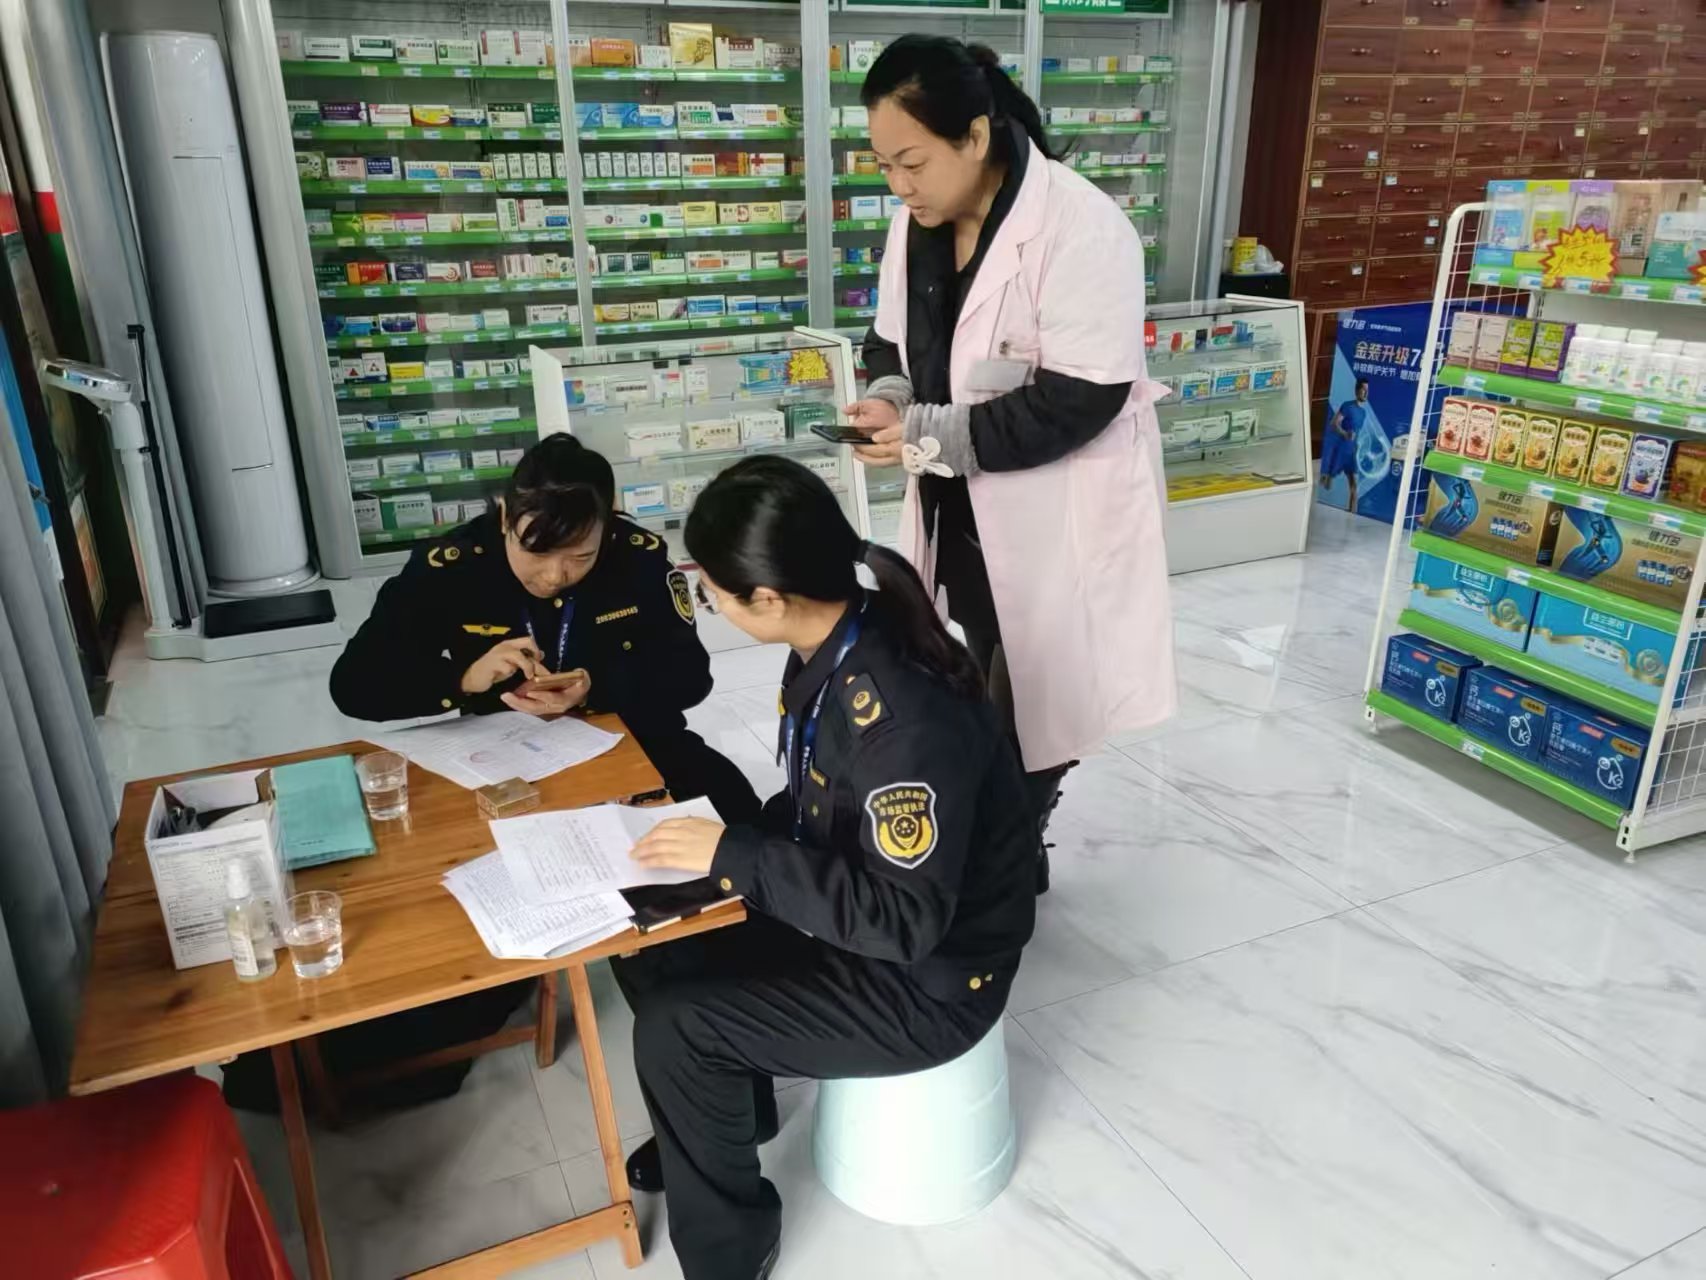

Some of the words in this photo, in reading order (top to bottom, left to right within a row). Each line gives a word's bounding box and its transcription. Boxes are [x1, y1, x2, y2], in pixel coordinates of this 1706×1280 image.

[1353, 341, 1424, 367] 金装升级7
[873, 790, 928, 809] 中华人民共和国
